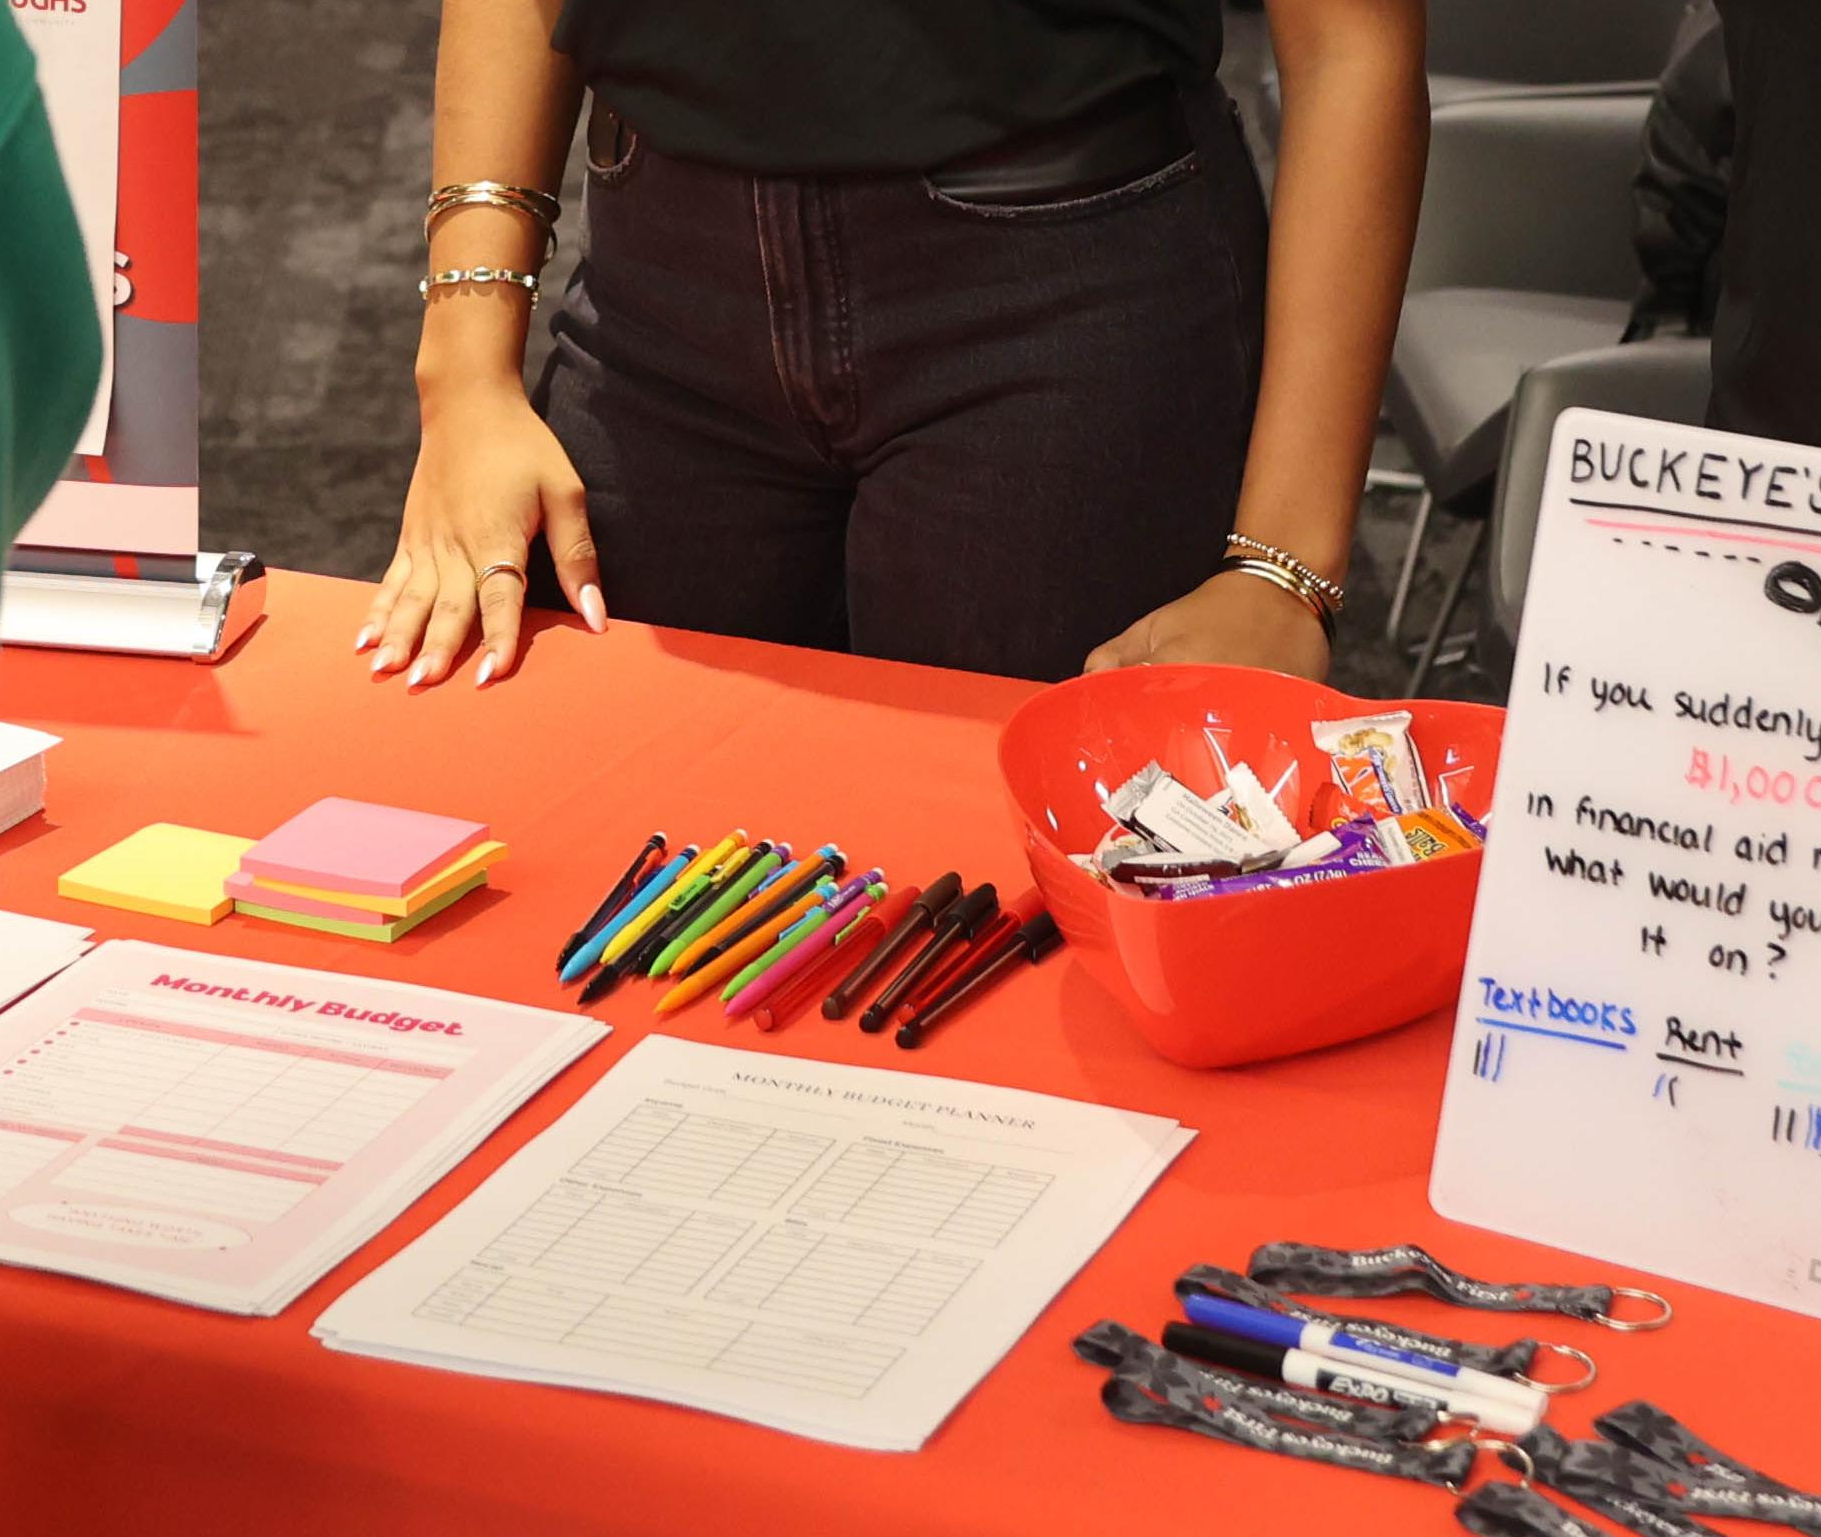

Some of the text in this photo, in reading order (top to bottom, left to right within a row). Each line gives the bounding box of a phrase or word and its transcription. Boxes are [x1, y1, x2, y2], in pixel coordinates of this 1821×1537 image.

[1542, 661, 1572, 696] If
[1590, 677, 1654, 719] you
[1575, 793, 1714, 854] financial
[1735, 830, 1789, 869] aid
[1648, 874, 1747, 919] would
[149, 973, 316, 1014] Monthly
[316, 1000, 464, 1038] Budget
[1477, 975, 1638, 1038] Textbooks
[1662, 1016, 1744, 1061] Rent
[731, 1070, 836, 1098] MONTHLY
[842, 1090, 933, 1113] BUDGET
[935, 1104, 1037, 1132] PLANNER
